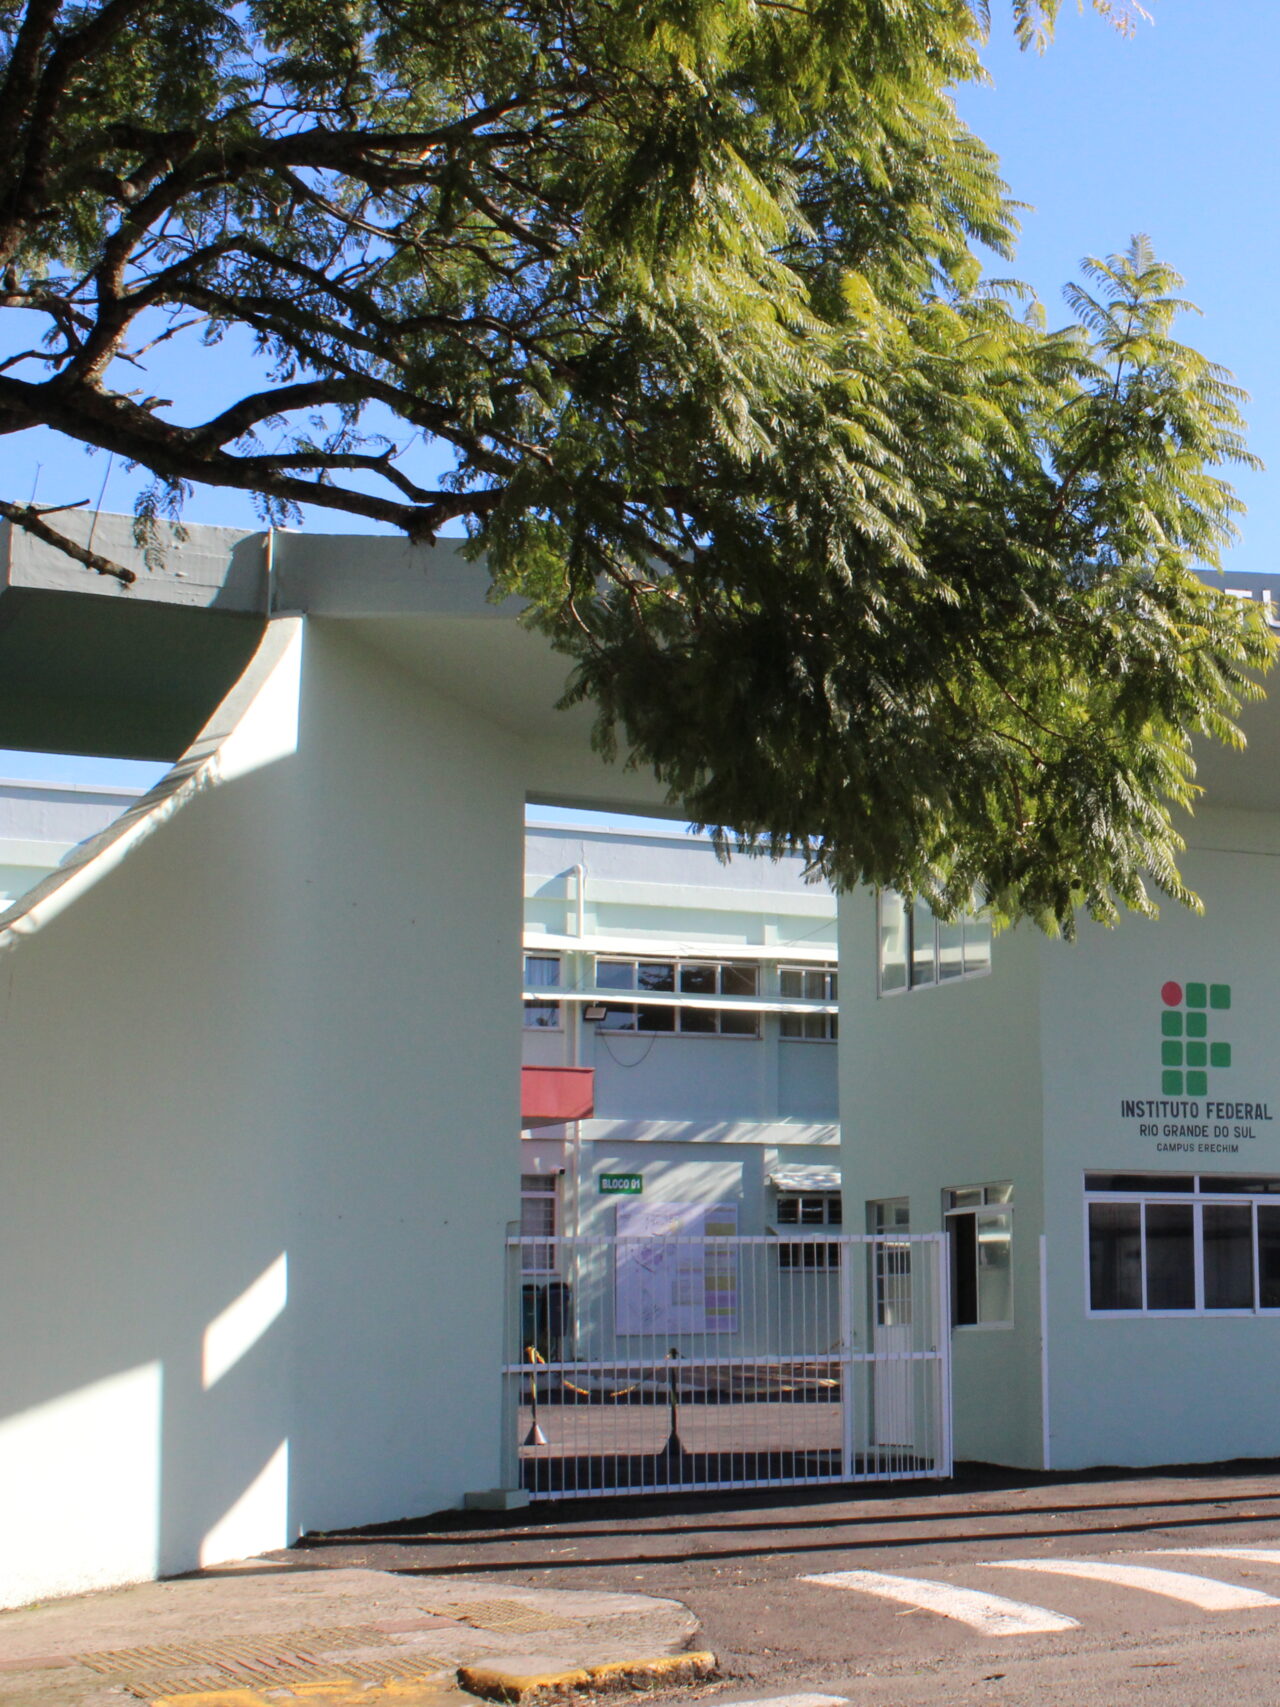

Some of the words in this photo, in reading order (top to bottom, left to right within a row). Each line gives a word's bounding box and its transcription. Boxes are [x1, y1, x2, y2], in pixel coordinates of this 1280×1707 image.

[1121, 1100, 1199, 1119] INSTITUTO
[1206, 1102, 1273, 1120] FEDERAL
[1139, 1124, 1159, 1137] RIO
[1163, 1125, 1208, 1137] GRANDE
[1214, 1126, 1229, 1137] DO
[1234, 1126, 1256, 1139] SUL
[1156, 1143, 1195, 1153] CAMPUS
[1199, 1144, 1239, 1153] ERECHIM
[602, 1178, 629, 1189] BLOCO
[631, 1178, 641, 1189] 01
